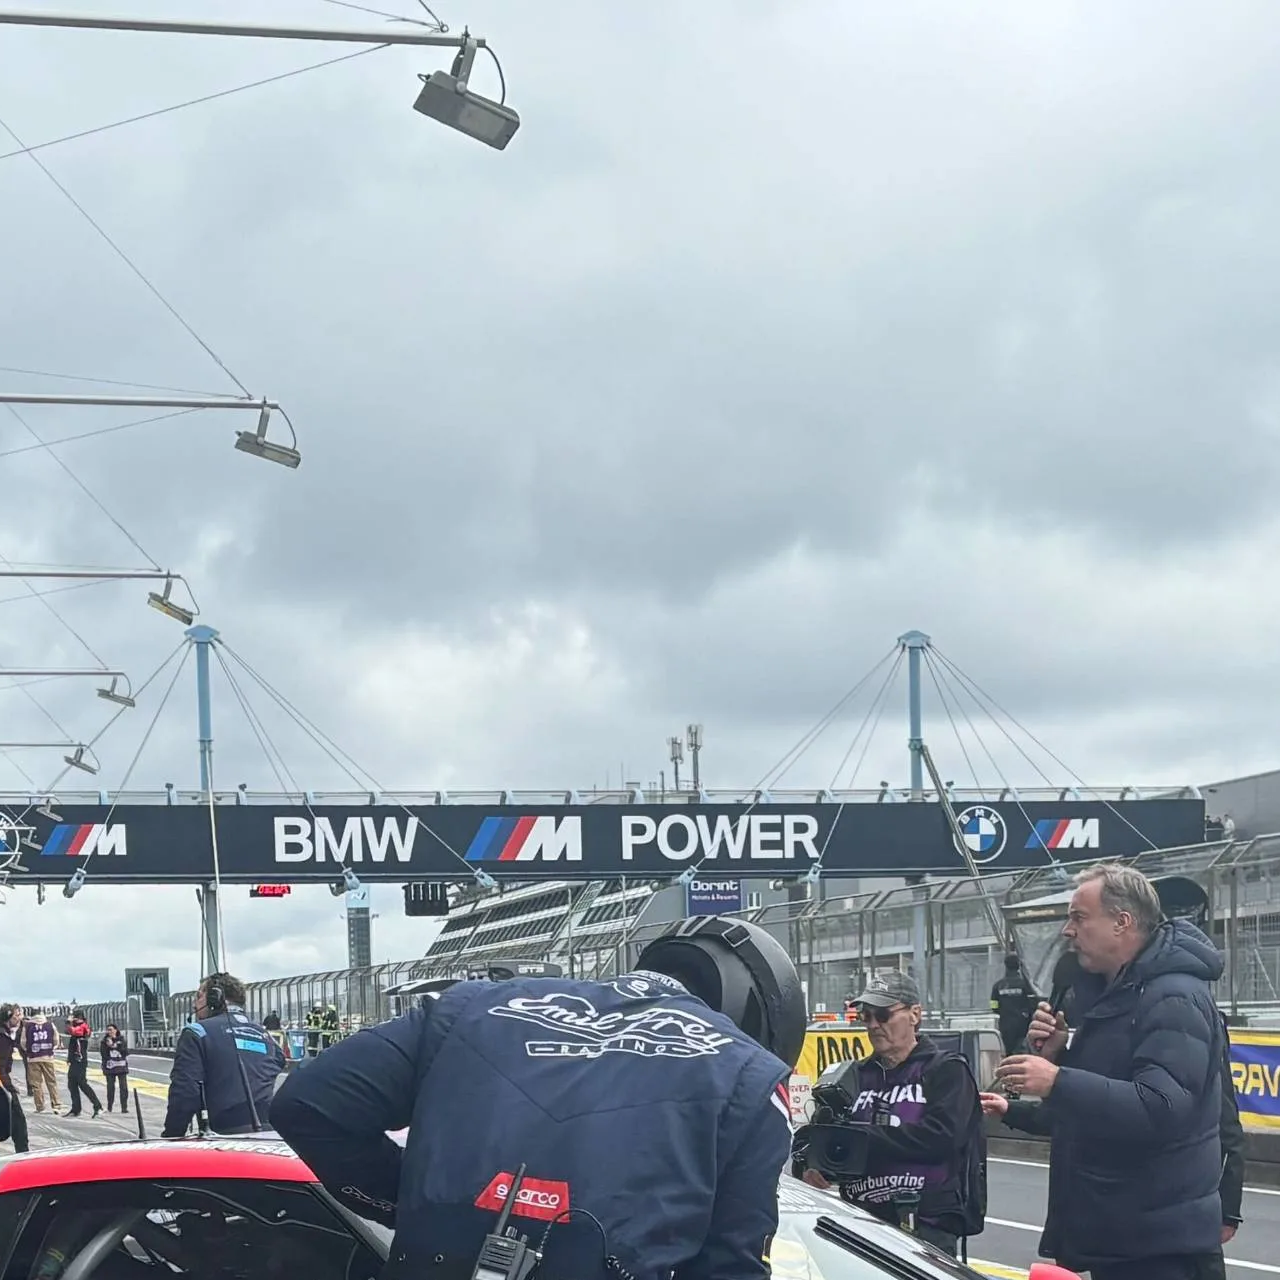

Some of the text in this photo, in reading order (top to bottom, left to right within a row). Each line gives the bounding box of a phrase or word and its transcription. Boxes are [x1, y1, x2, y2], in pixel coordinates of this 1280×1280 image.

[273, 816, 418, 863] BMW
[621, 814, 819, 861] POWER
[690, 880, 739, 892] Dorint
[507, 992, 624, 1030] Emil
[495, 1183, 560, 1209] sarco
